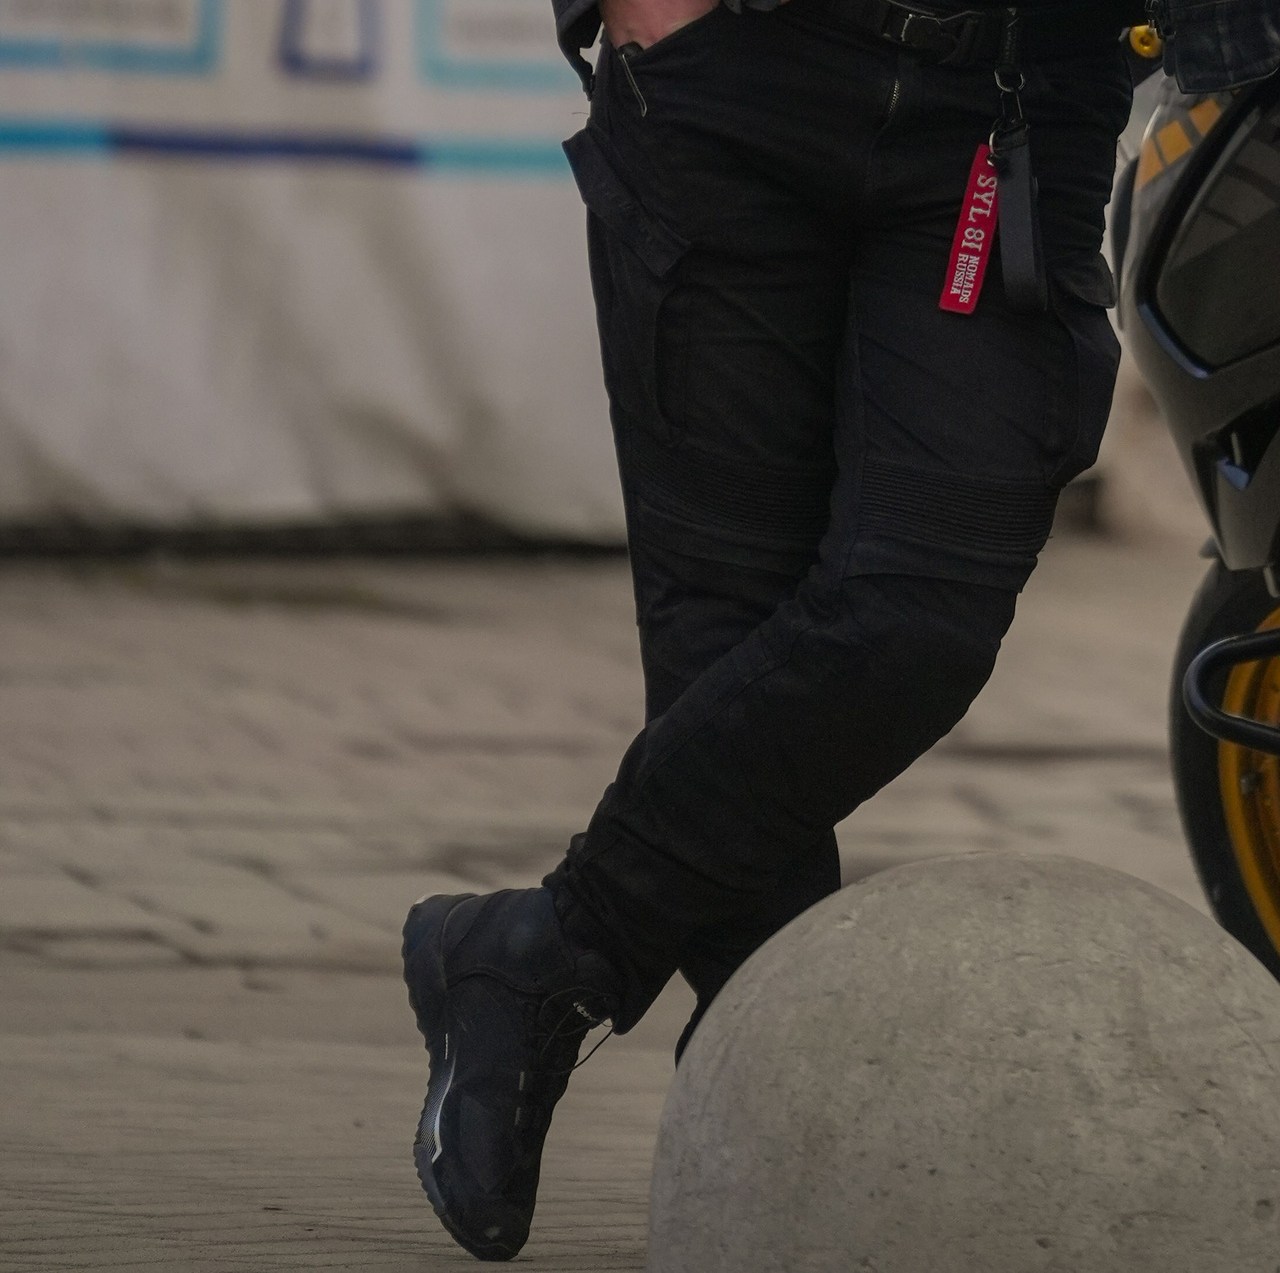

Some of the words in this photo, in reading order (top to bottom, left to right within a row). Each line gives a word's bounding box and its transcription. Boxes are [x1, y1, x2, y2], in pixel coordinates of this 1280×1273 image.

[967, 174, 998, 223] SYL
[961, 227, 985, 252] 81
[950, 253, 969, 295] RUSSIA
[959, 255, 980, 304] NOMADS
